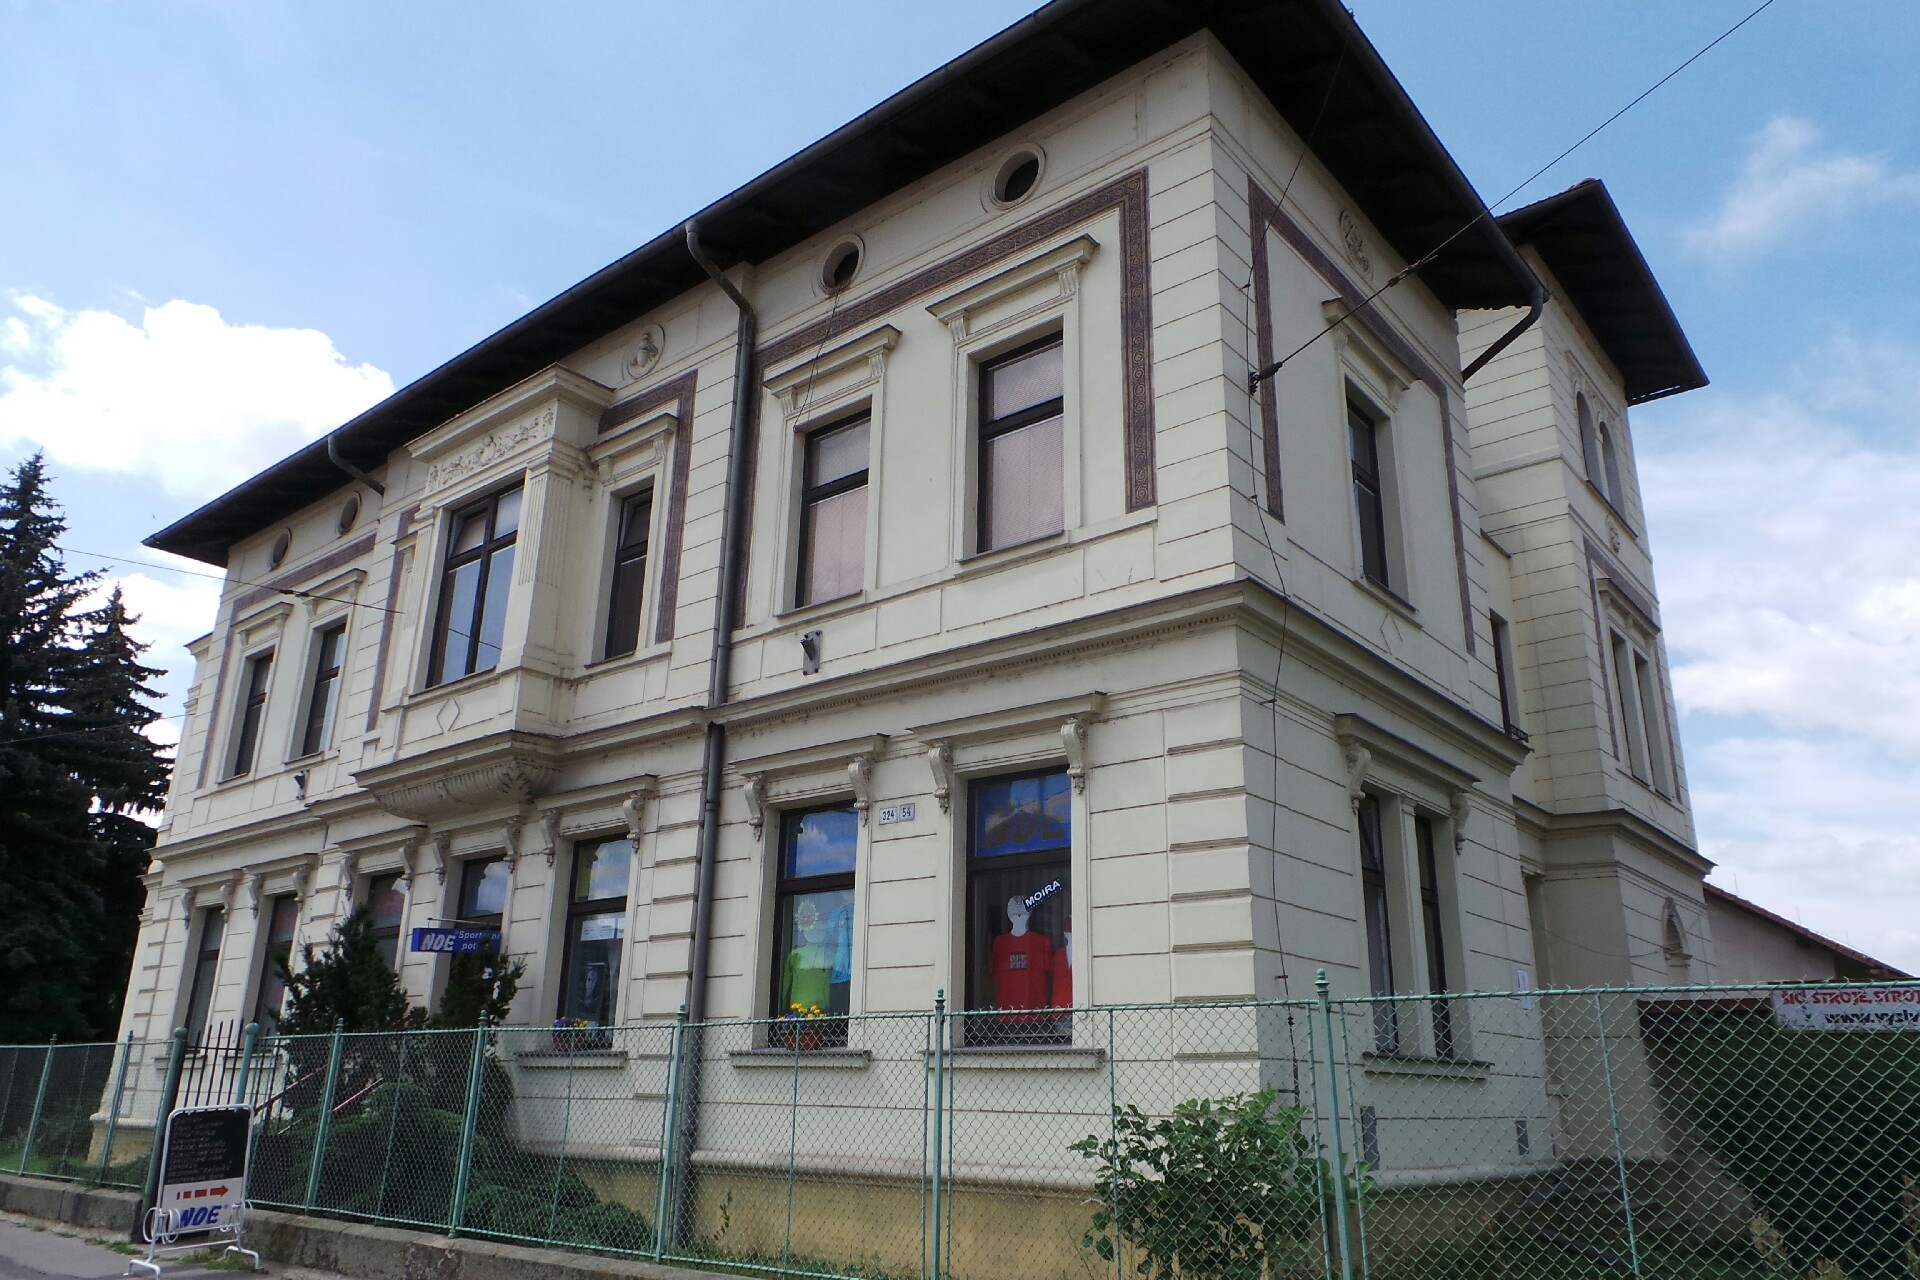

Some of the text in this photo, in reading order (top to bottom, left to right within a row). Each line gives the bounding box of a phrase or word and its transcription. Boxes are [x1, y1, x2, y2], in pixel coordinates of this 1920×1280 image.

[882, 810, 895, 821] 324
[902, 807, 911, 818] 54
[1025, 880, 1060, 907] MOIRA
[421, 932, 456, 951] NOE
[176, 1205, 222, 1229] NOE
